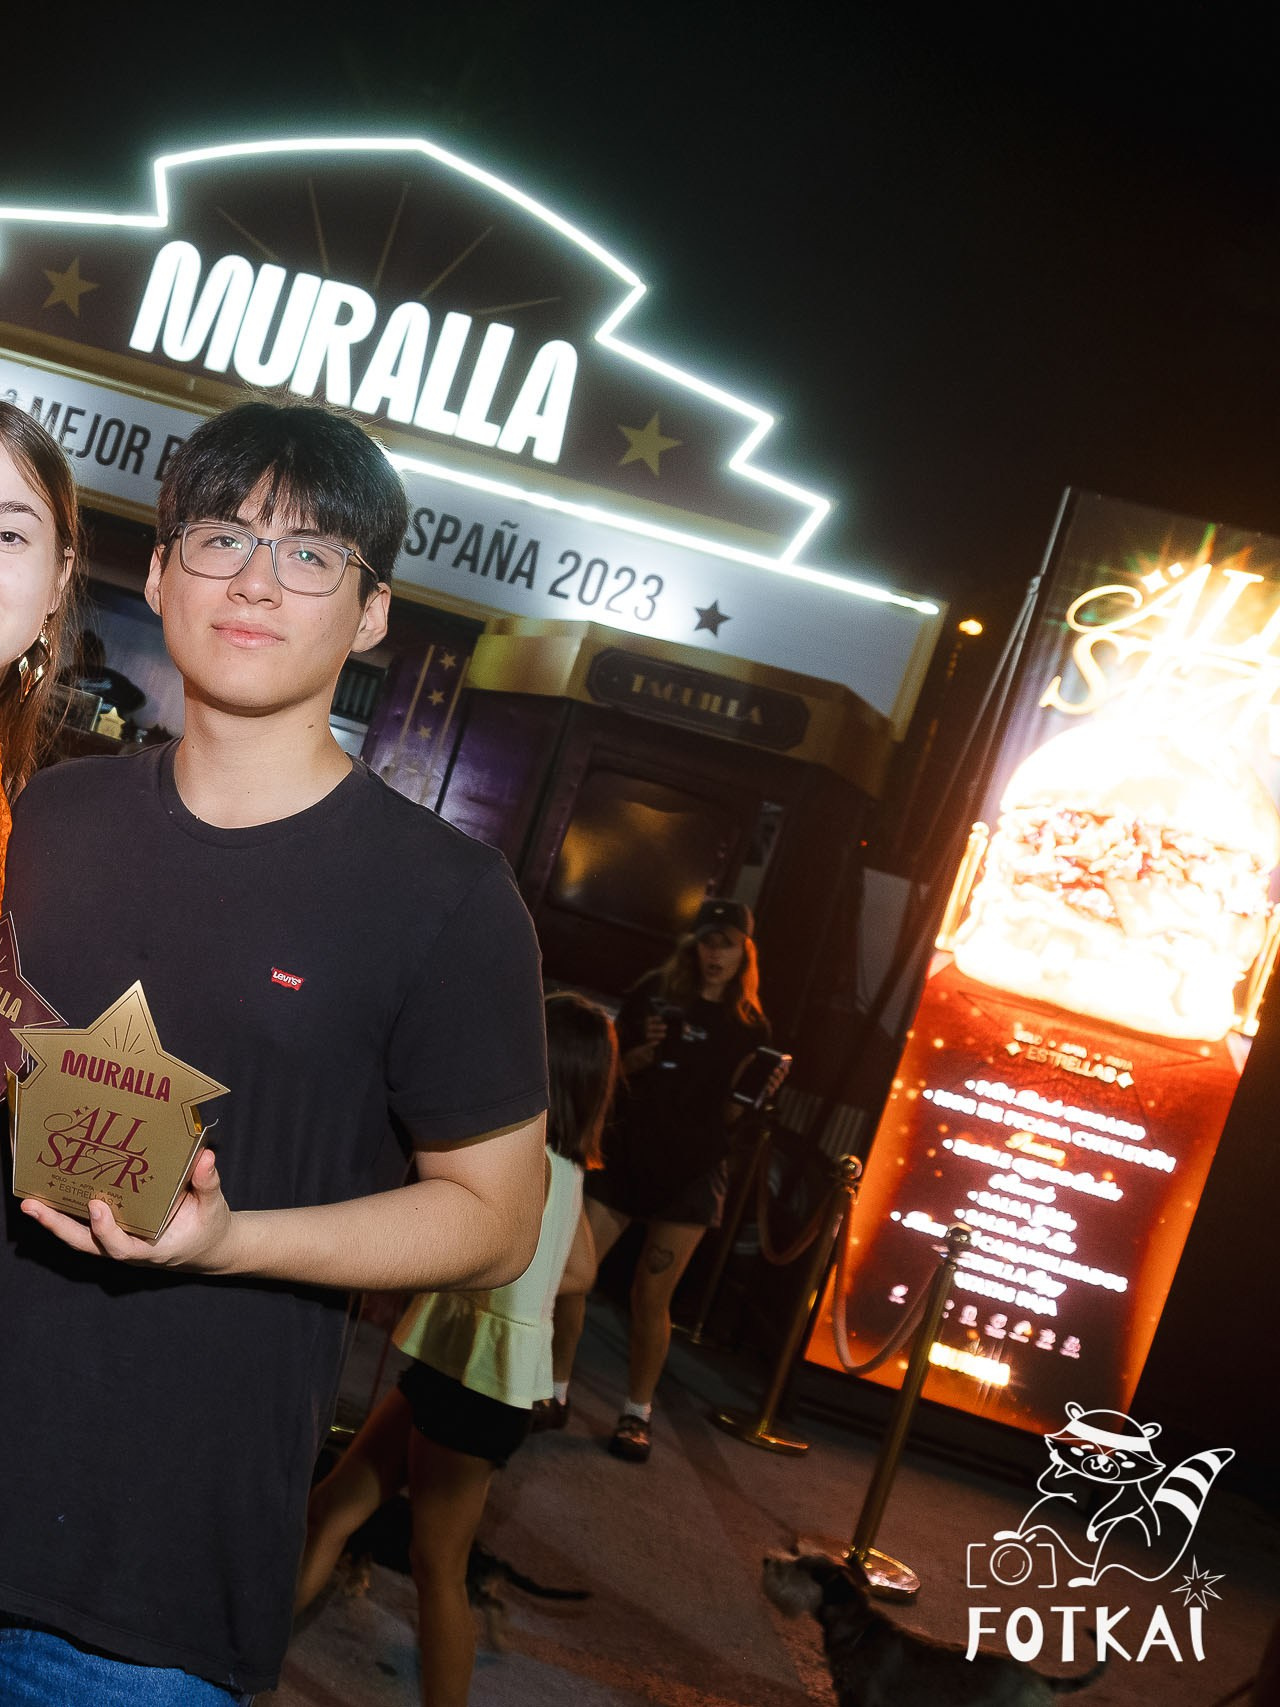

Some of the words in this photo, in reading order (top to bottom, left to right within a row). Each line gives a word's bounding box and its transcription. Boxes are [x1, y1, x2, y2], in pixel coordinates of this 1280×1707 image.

[129, 240, 578, 465] MURALLA
[29, 396, 152, 475] MEJOR
[404, 507, 540, 590] SPAÑA
[548, 549, 665, 622] 2023
[60, 1049, 171, 1103] MURALLA
[43, 1107, 148, 1156] ALL
[36, 1132, 149, 1194] STAR
[59, 1183, 114, 1206] ESTRELLAS
